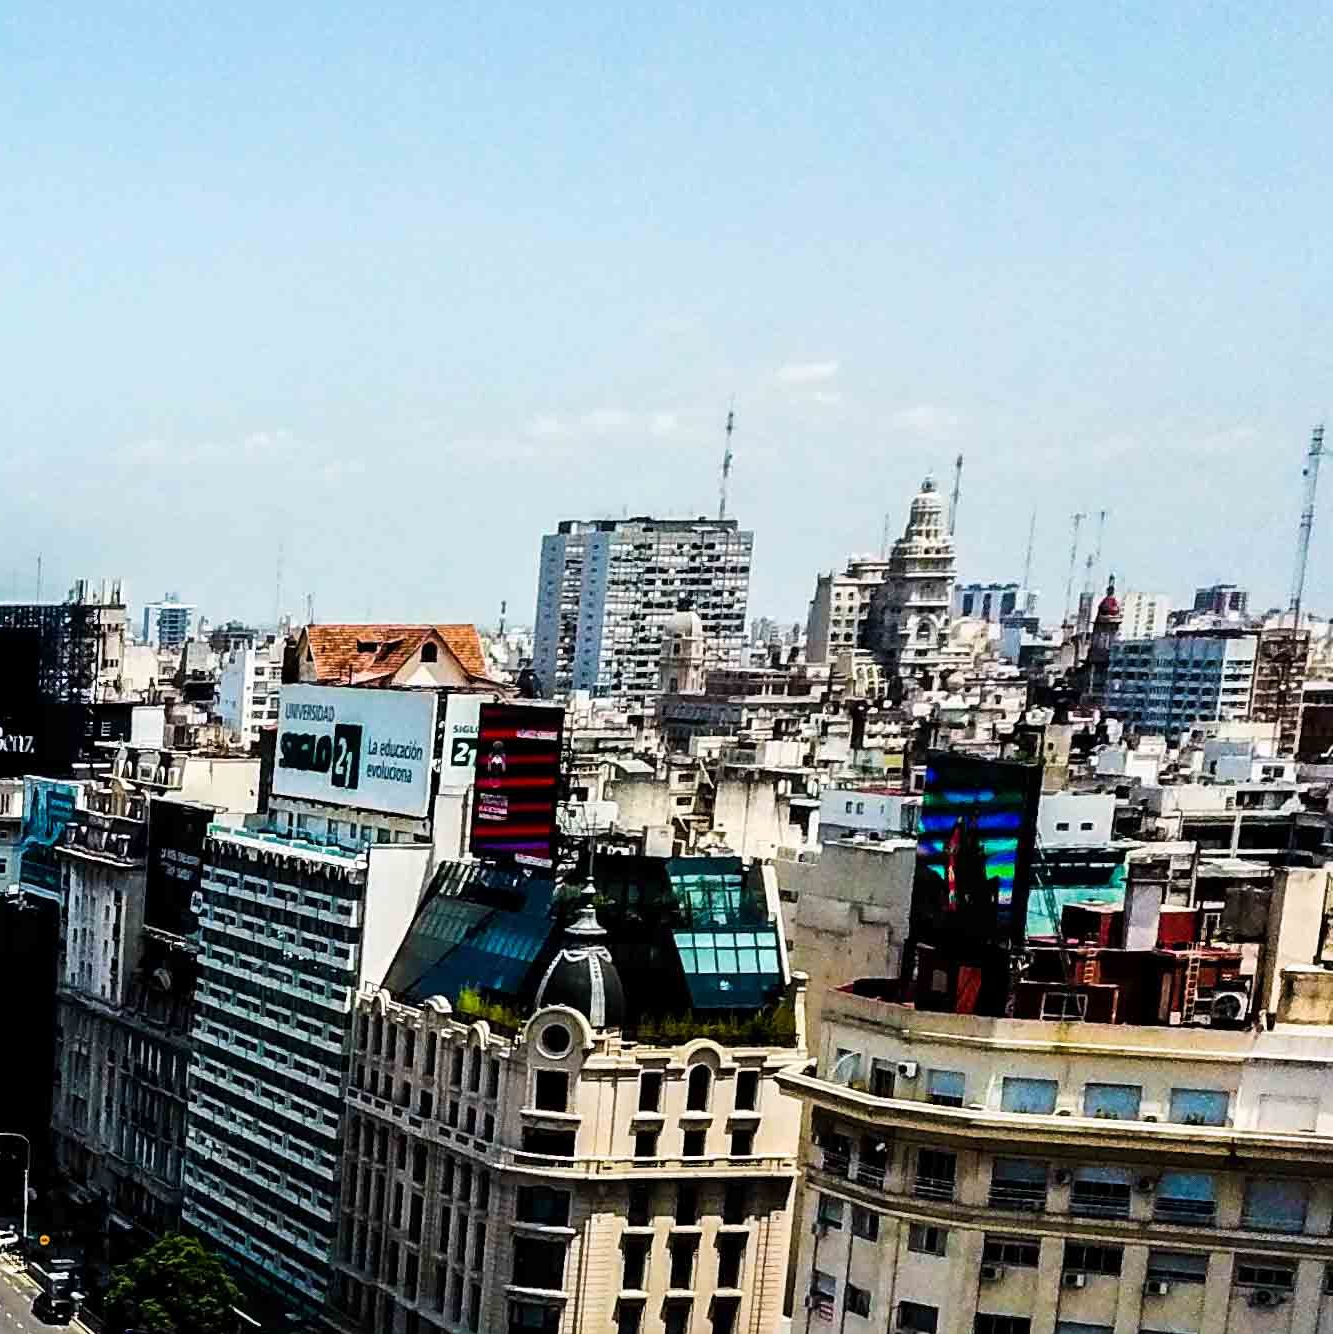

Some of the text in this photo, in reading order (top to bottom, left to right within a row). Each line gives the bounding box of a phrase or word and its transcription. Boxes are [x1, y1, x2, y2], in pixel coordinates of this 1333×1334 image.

[285, 703, 335, 722] UNIVERSIDAD
[452, 724, 479, 734] SIGL
[368, 736, 423, 762] La educación
[335, 736, 353, 787] 21
[367, 762, 412, 783] evoluciona
